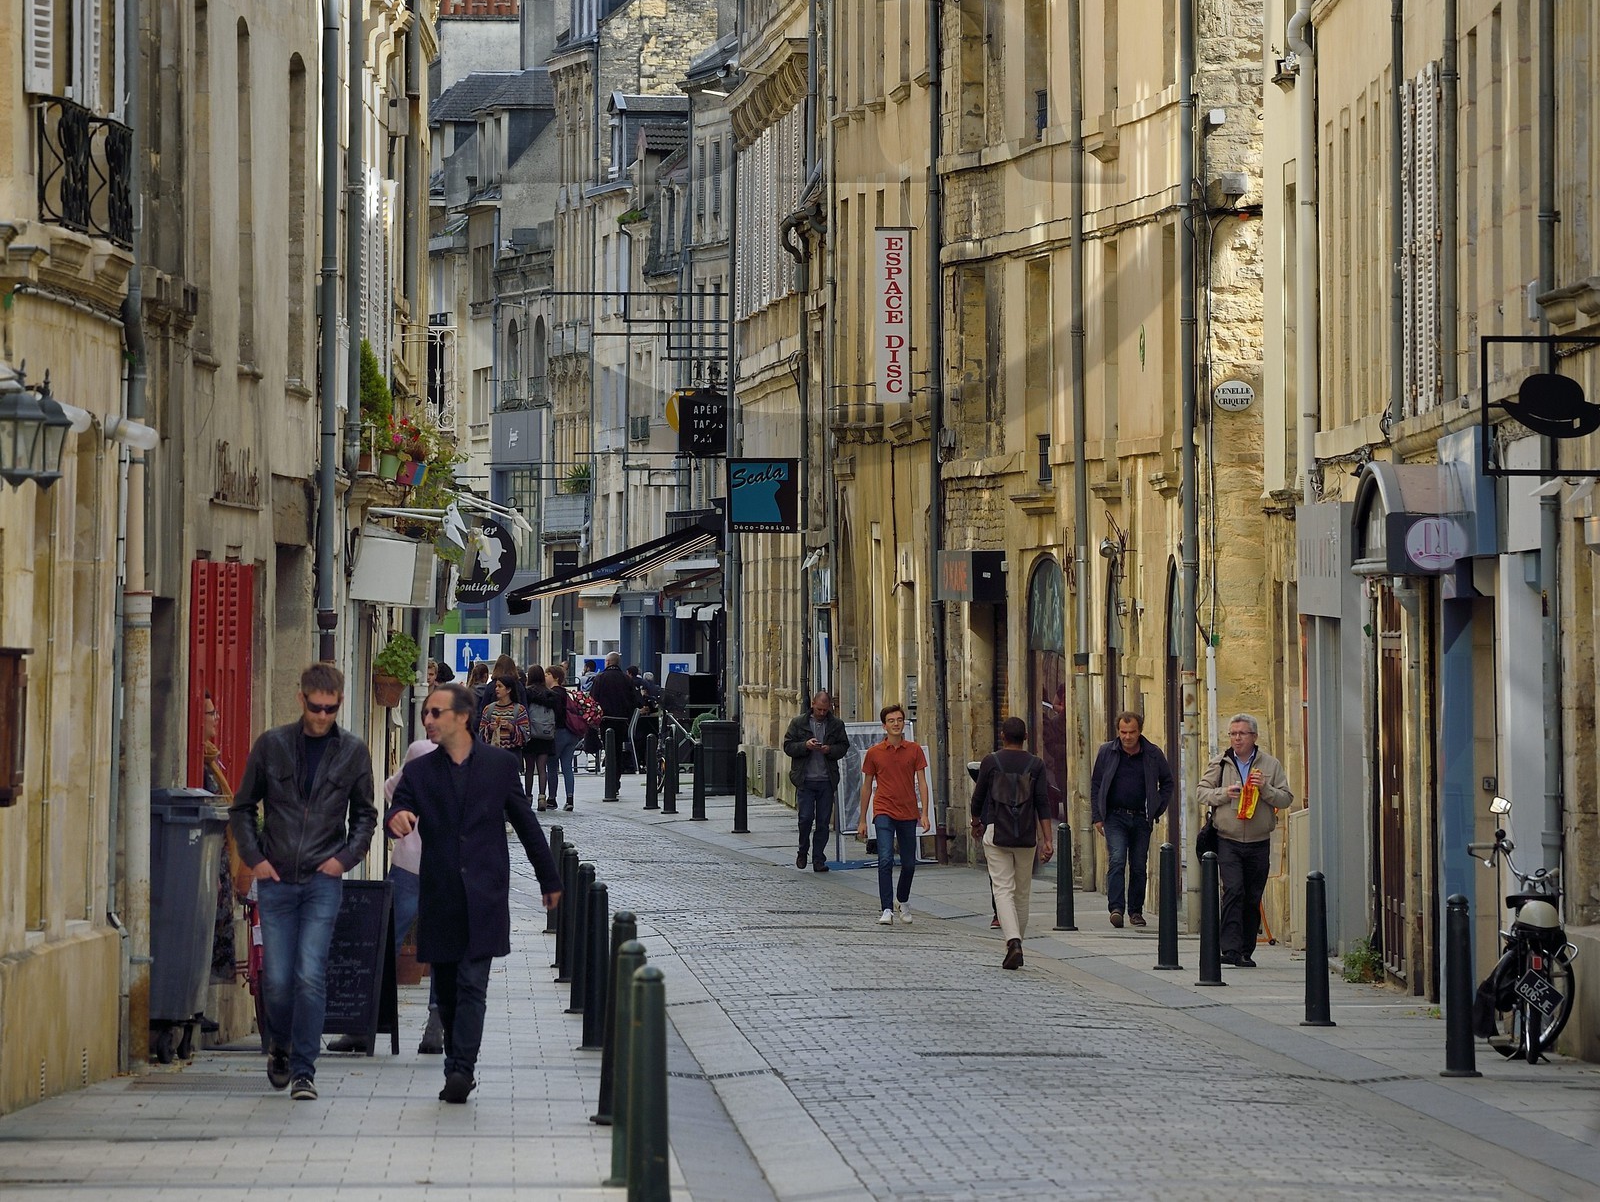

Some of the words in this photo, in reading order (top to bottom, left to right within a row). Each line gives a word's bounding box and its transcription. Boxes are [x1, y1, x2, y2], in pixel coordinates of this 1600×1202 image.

[884, 237, 903, 324] ESPACE
[885, 335, 904, 393] DISC
[1217, 387, 1250, 395] VENELLE
[1218, 398, 1250, 407] CRIQUET
[731, 463, 786, 490] Scala
[733, 524, 791, 532] Déco-Design
